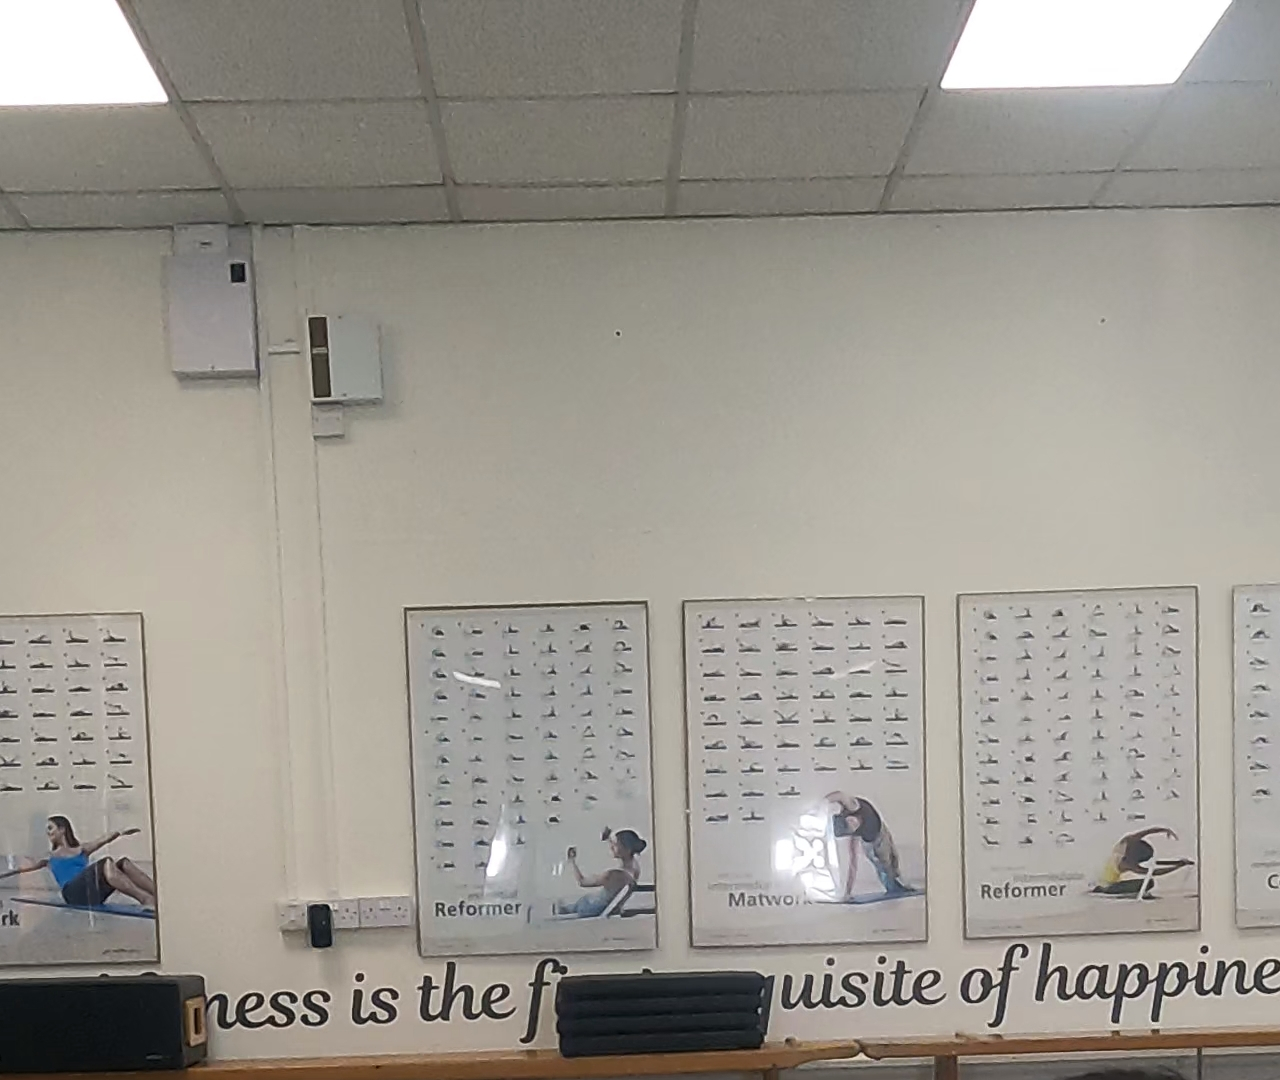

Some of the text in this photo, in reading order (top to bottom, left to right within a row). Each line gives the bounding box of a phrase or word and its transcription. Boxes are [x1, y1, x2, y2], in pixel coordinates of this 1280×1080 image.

[434, 901, 522, 917] Reformer
[980, 882, 1067, 899] Reformer
[205, 989, 331, 1030] ness
[351, 972, 400, 1026] is
[417, 961, 517, 1023] the
[960, 943, 1029, 1028] of
